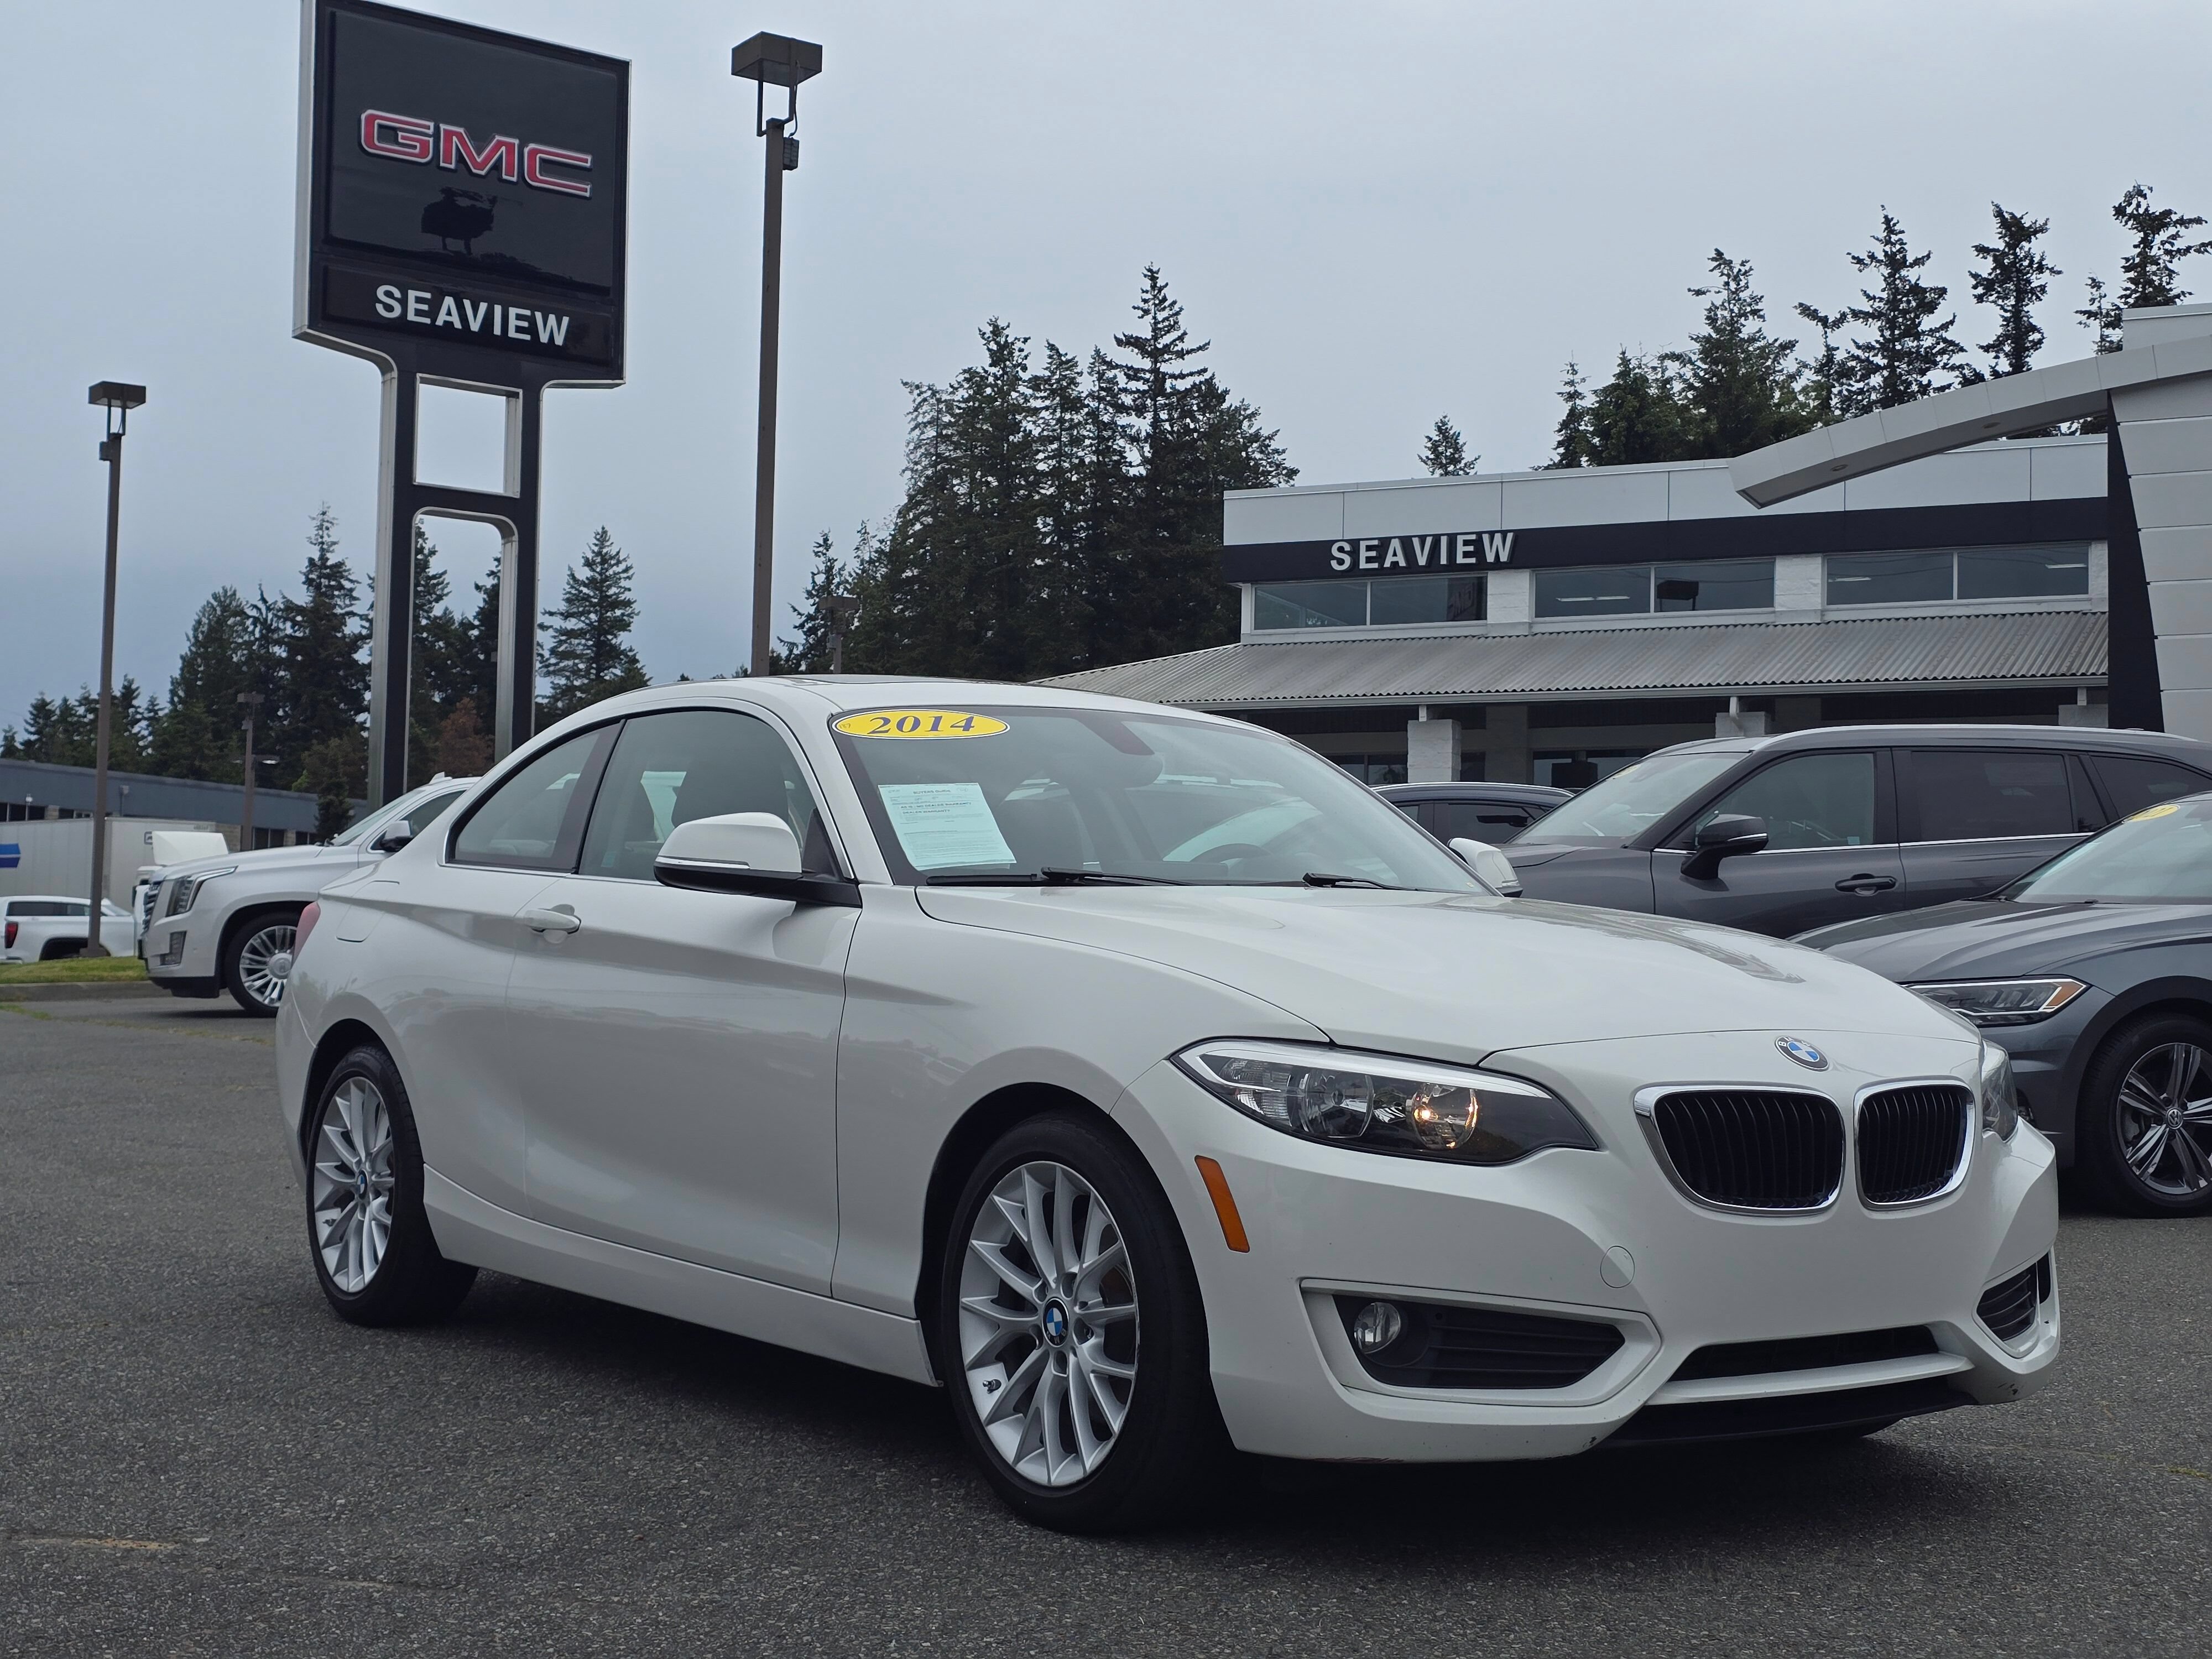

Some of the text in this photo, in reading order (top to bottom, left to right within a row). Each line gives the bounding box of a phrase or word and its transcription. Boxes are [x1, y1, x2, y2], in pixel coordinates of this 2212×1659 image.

[361, 109, 592, 197] GMC
[375, 285, 569, 346] SEAVIEW
[1330, 532, 1514, 571] SEAVIEW
[867, 716, 975, 734] 2014
